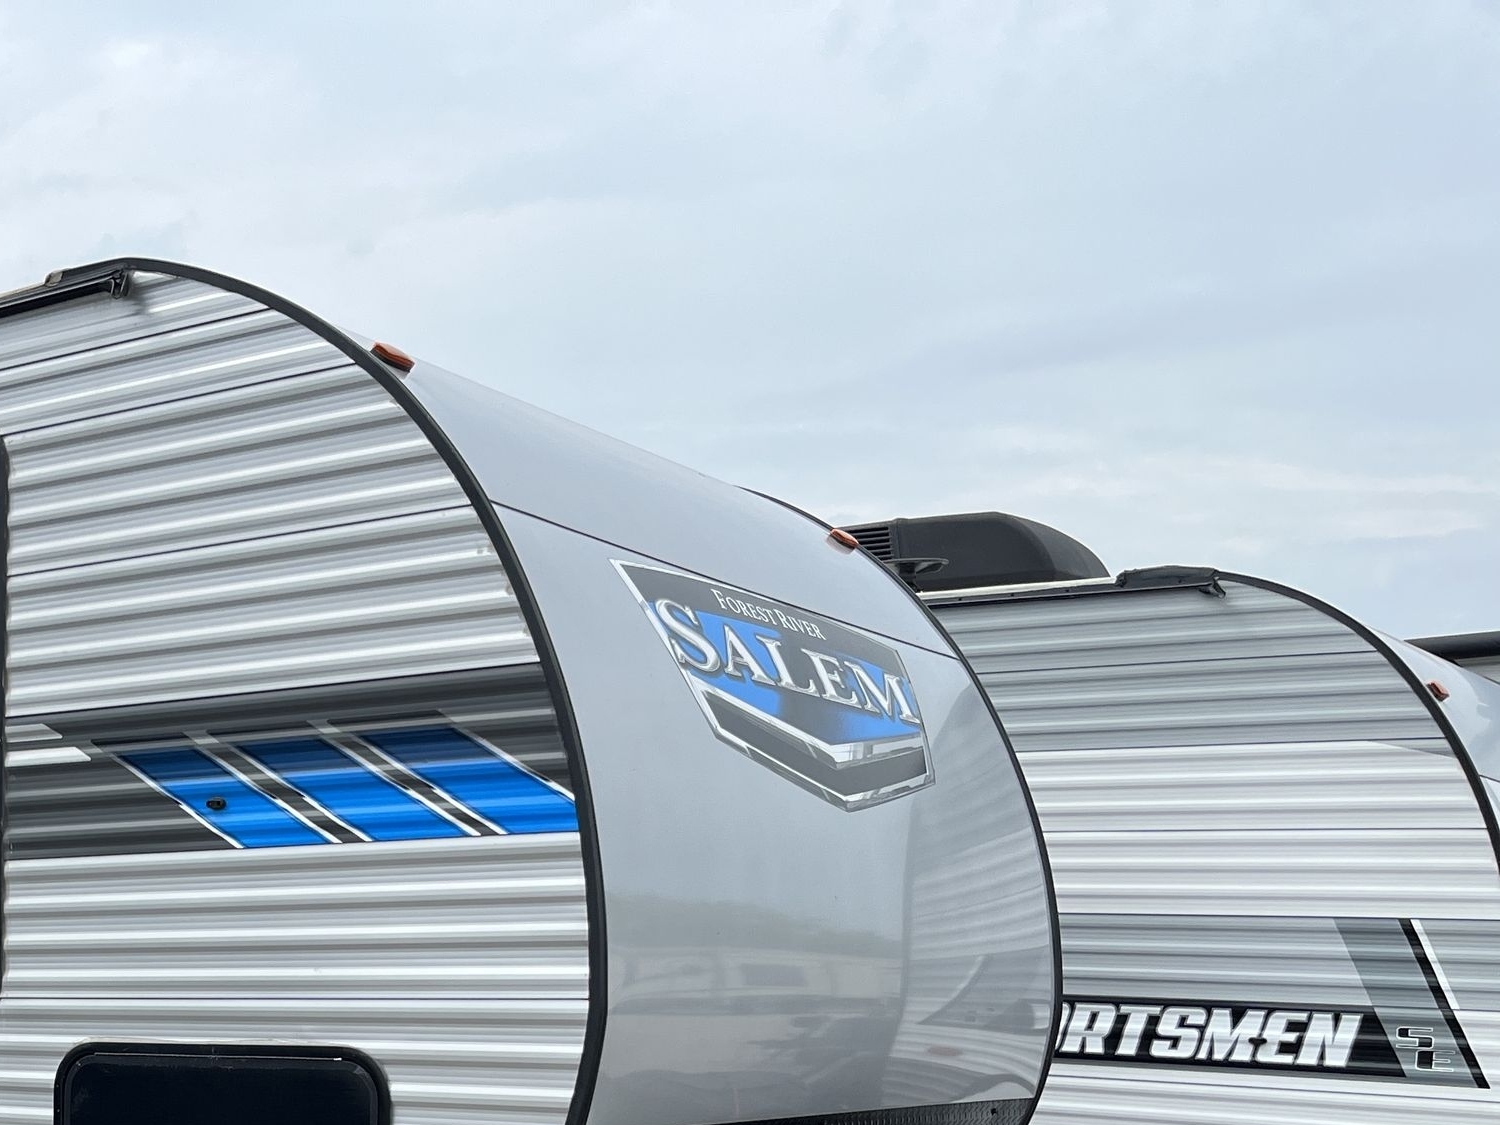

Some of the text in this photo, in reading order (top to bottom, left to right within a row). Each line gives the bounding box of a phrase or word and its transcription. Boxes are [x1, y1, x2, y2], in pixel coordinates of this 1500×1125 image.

[710, 588, 827, 641] FOREST RIVER
[653, 598, 921, 724] SALEM
[1055, 1002, 1364, 1068] RTSMEN
